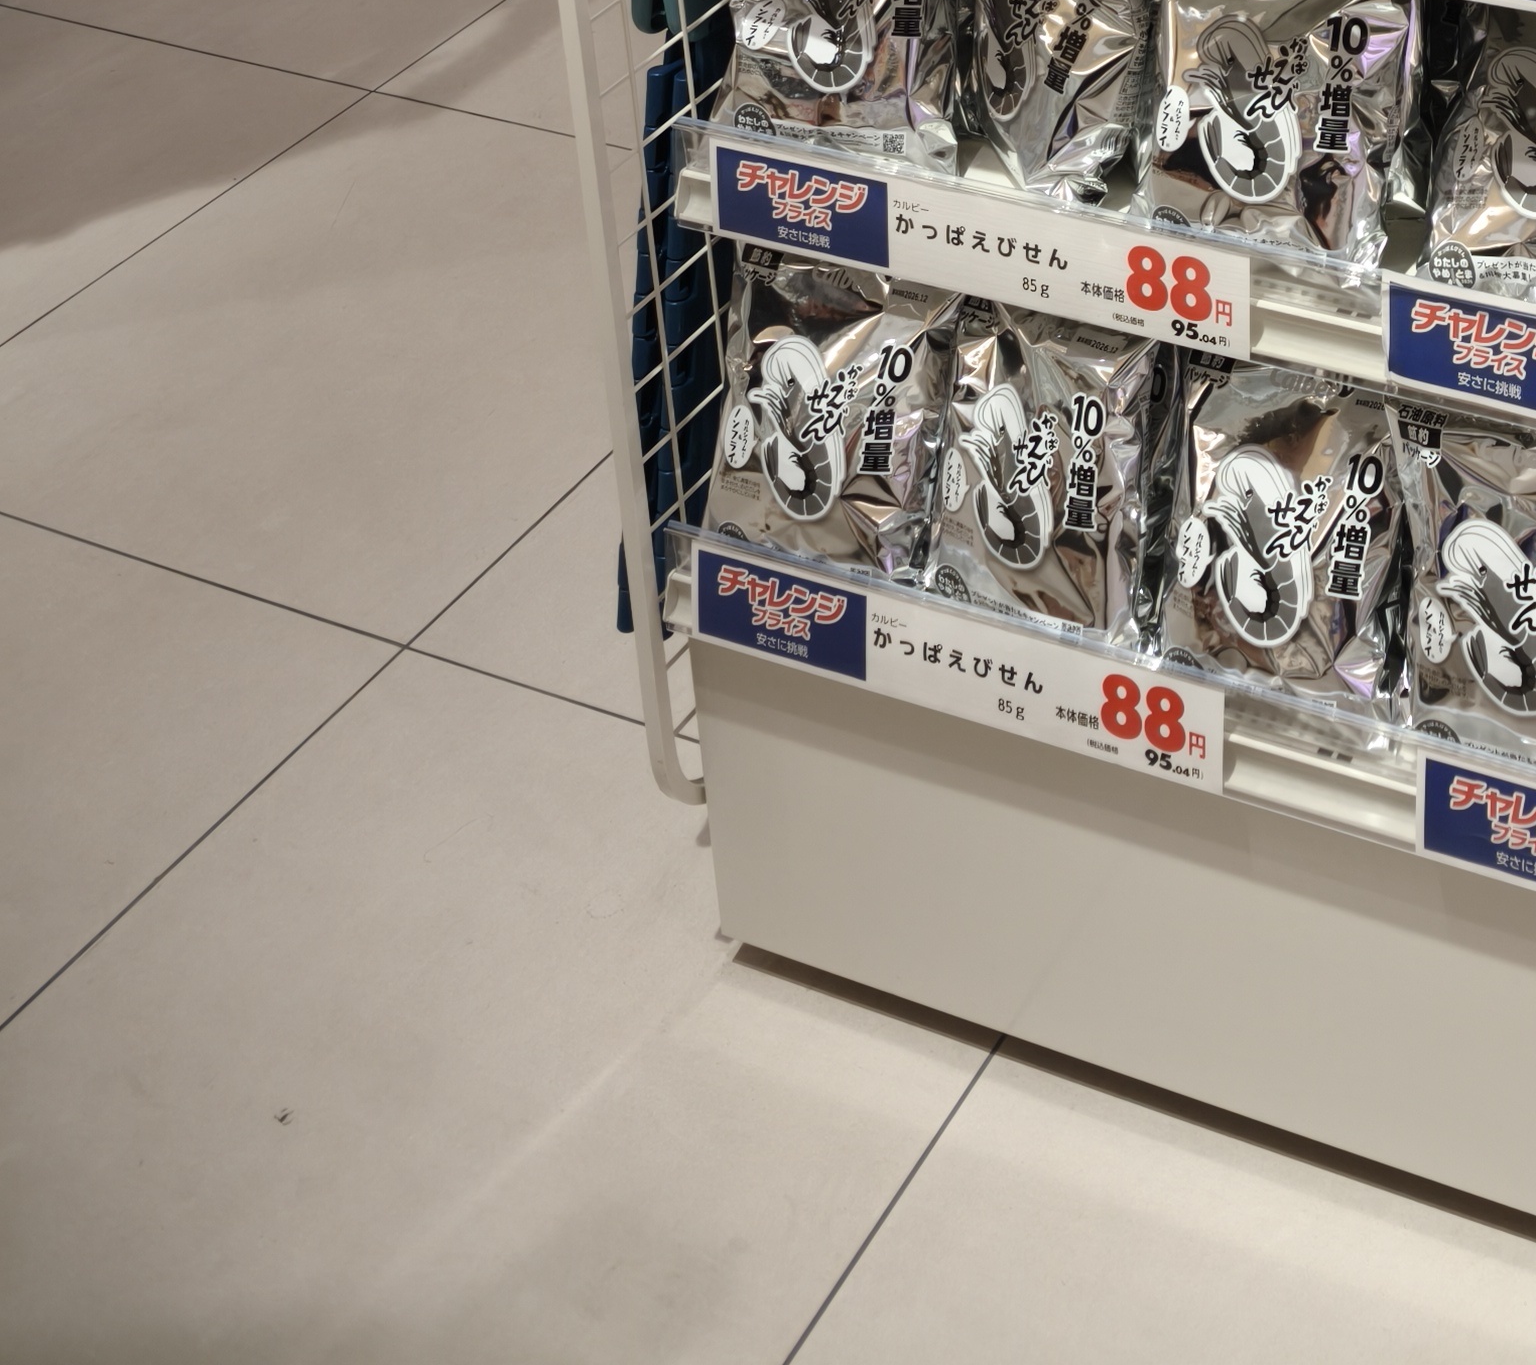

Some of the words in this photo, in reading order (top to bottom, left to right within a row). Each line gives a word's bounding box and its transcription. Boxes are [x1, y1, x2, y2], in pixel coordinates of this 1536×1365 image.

[895, 213, 1069, 271] かっぱえびせん
[1451, 339, 1528, 381] プライス
[1457, 371, 1522, 401] 安さに挑戦
[873, 627, 1044, 695] かっぱえびせん
